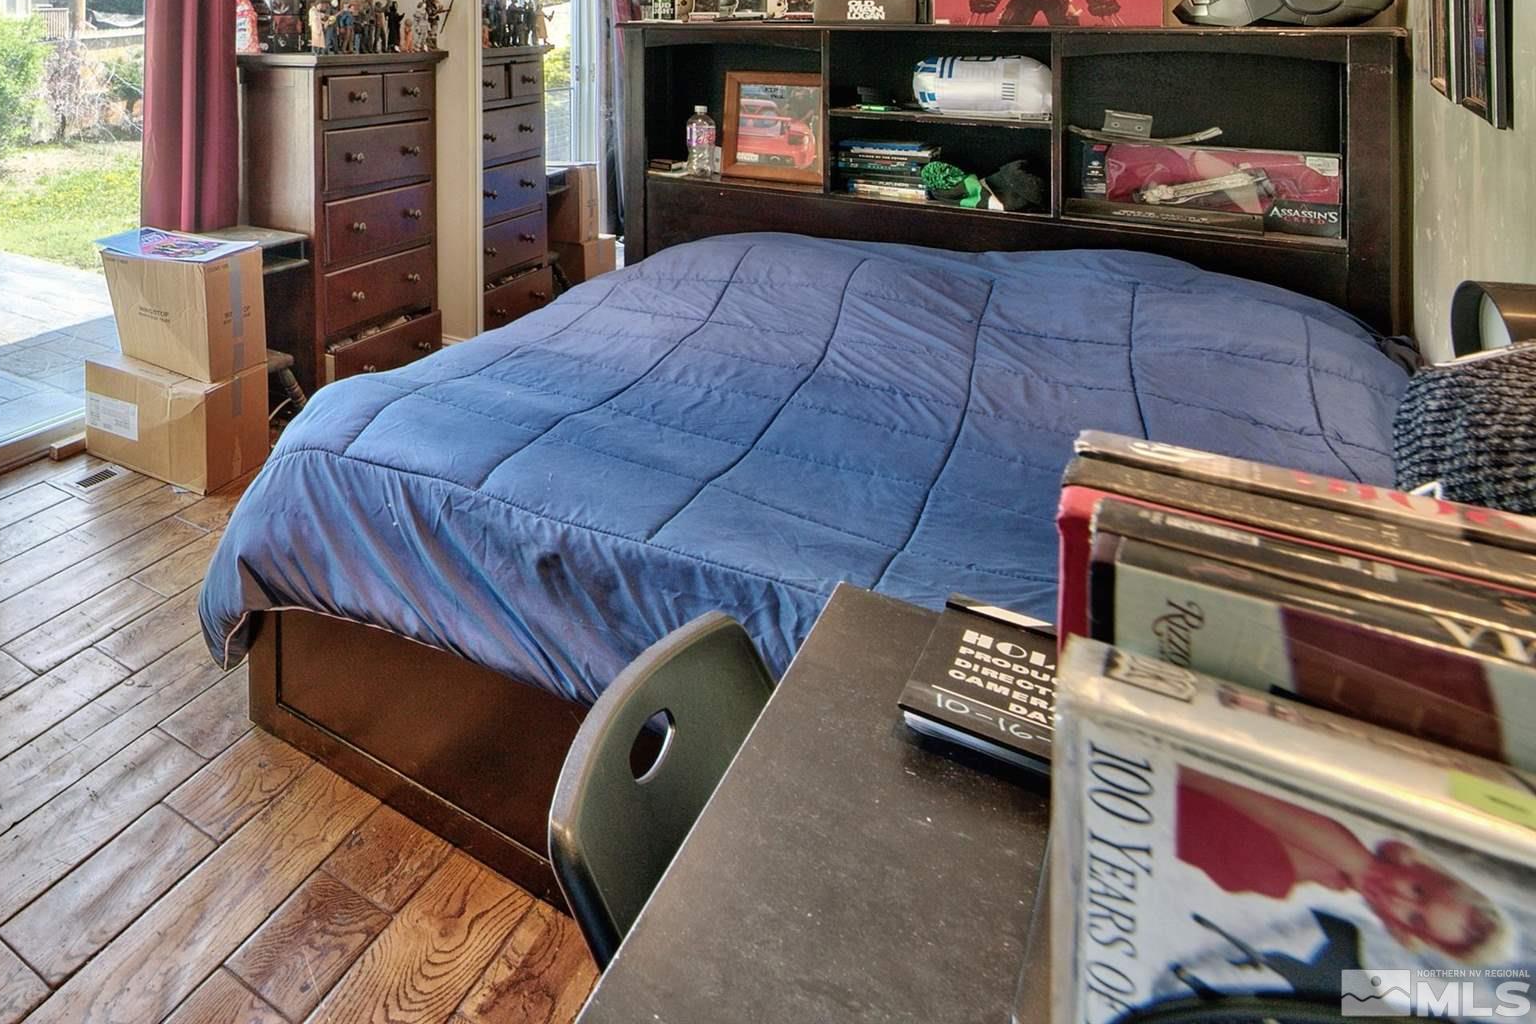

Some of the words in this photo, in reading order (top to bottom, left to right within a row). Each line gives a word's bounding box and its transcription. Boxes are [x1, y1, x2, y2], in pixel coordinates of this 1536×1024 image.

[847, 12, 885, 20] LOGAN
[1269, 207, 1339, 222] ASSASSIN'S
[1088, 741, 1156, 826] 100
[1087, 832, 1153, 960] YEARS
